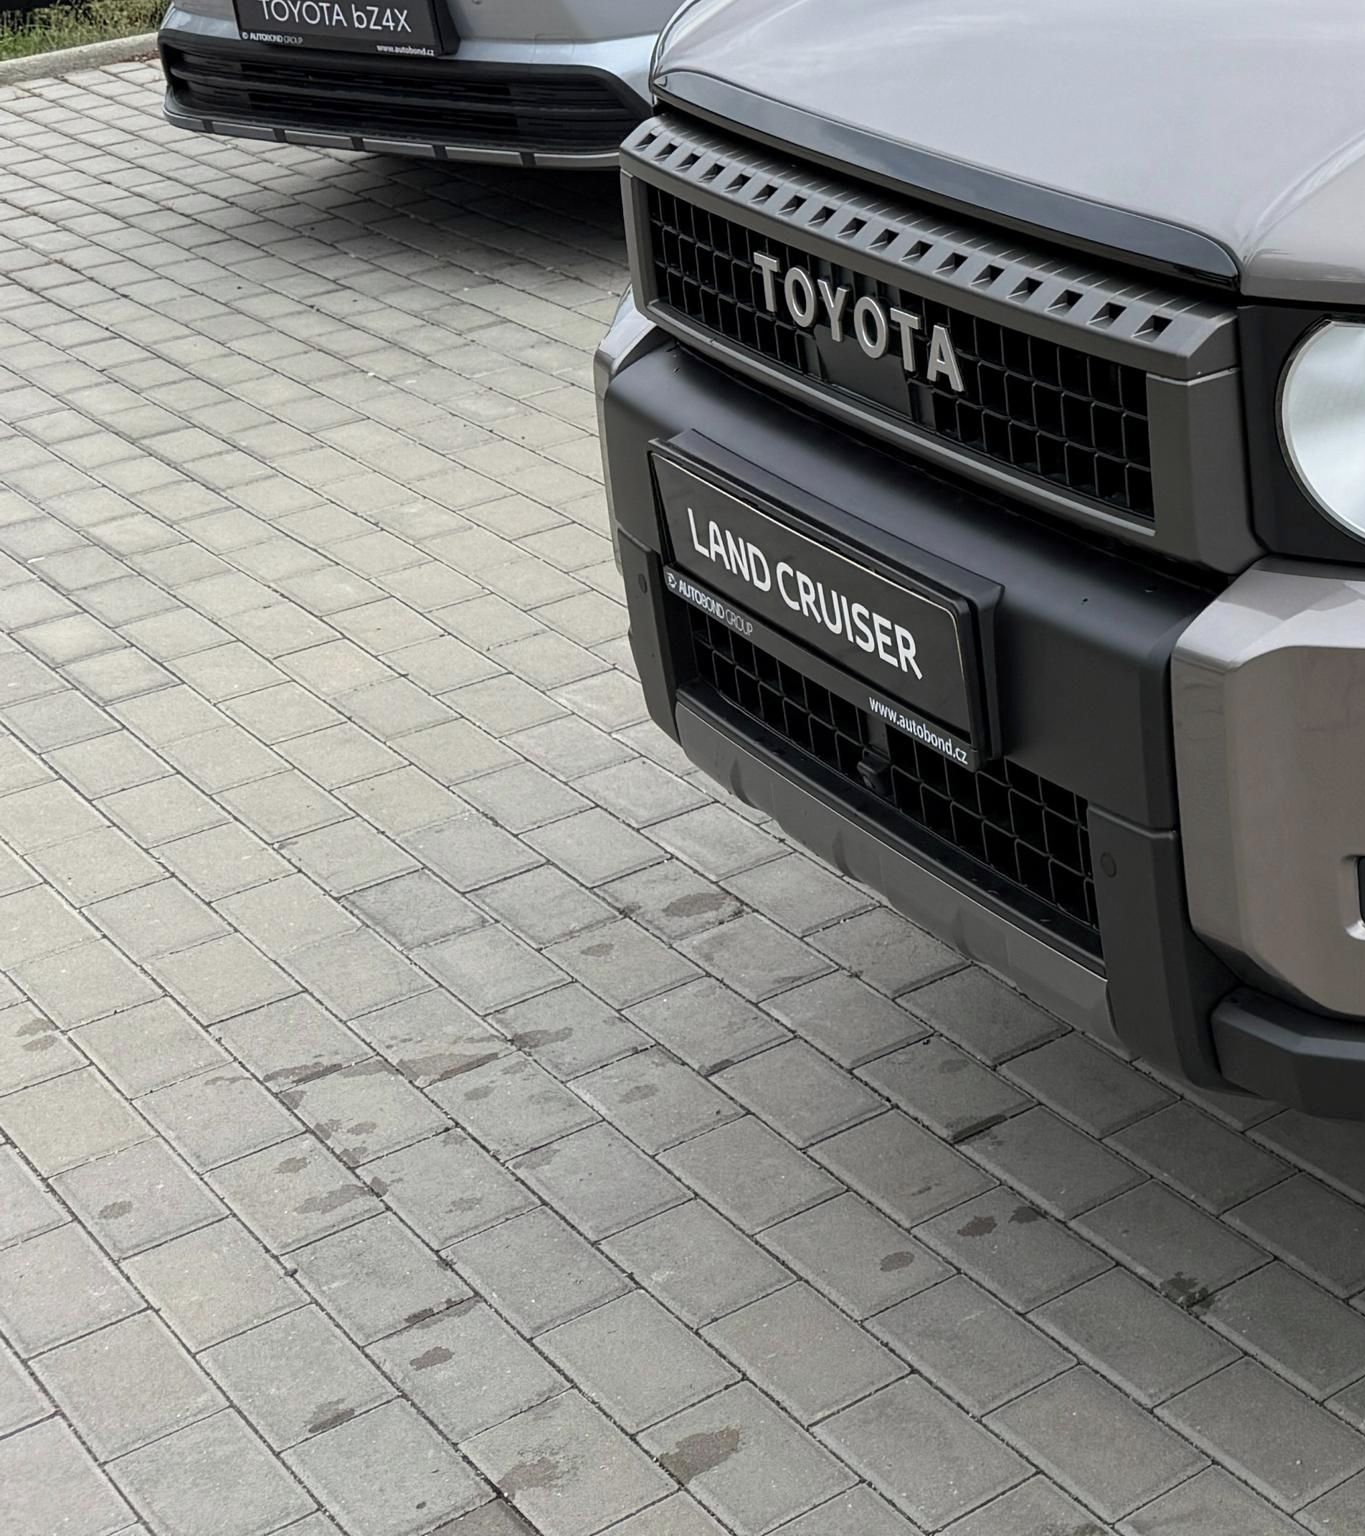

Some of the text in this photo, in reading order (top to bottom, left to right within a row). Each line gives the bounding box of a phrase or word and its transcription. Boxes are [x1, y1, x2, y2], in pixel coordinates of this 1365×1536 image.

[351, 4, 412, 33] bZ4X
[376, 44, 435, 57] www.autobond.cz
[754, 252, 965, 393] TOYOTA
[678, 579, 753, 637] AUTOBOND GROUP
[687, 508, 923, 680] LAND CRUISER
[868, 695, 969, 765] www.autobond.cz
